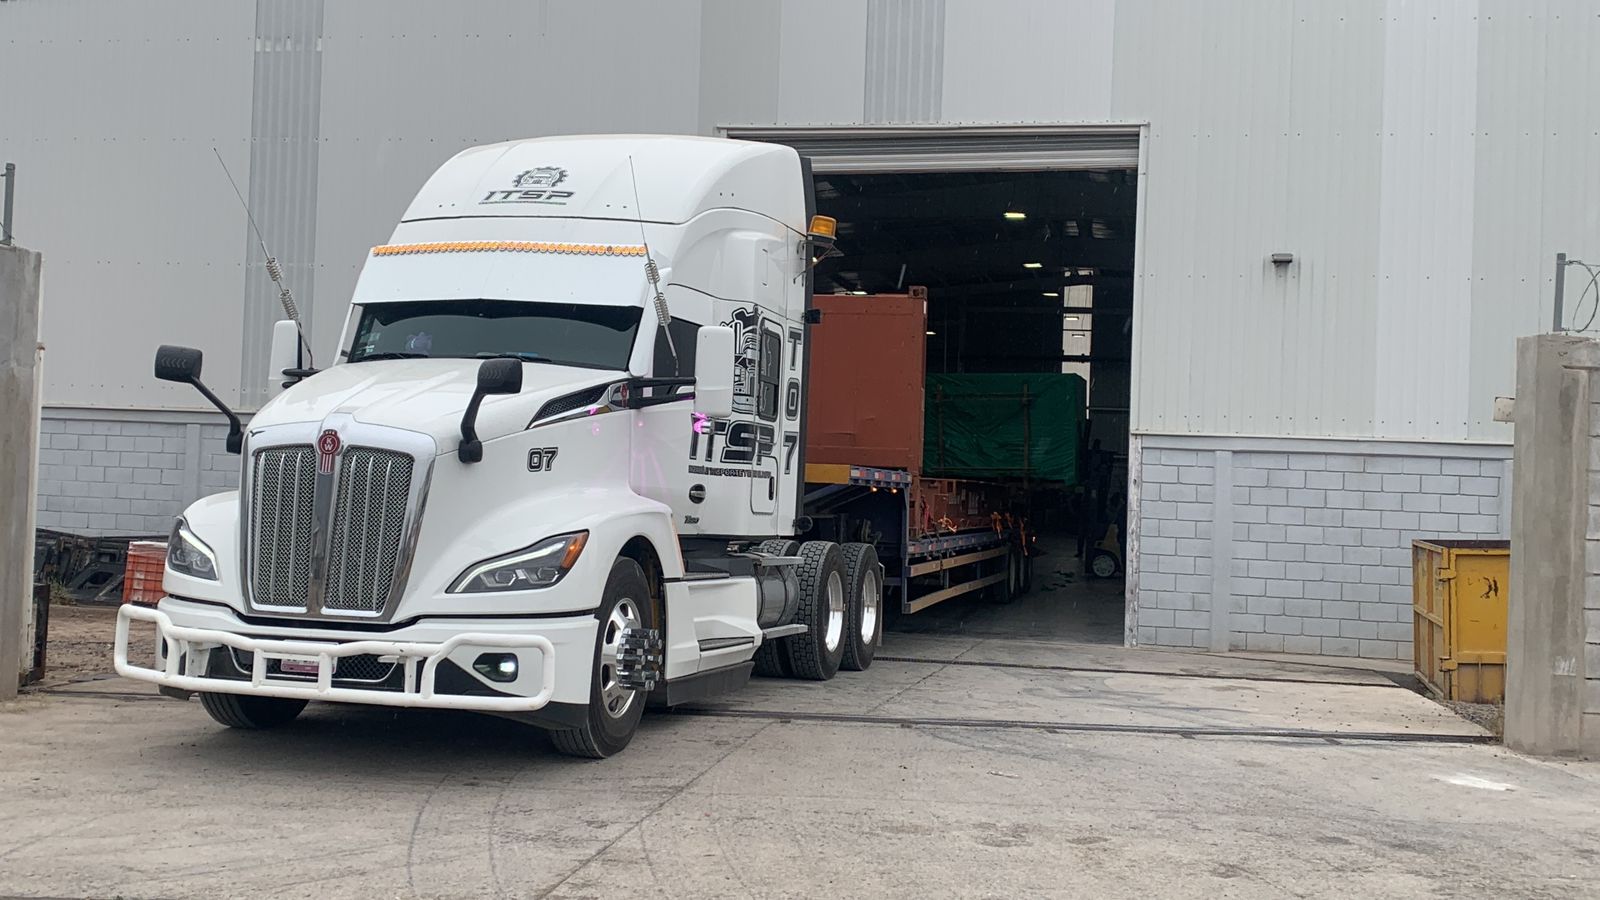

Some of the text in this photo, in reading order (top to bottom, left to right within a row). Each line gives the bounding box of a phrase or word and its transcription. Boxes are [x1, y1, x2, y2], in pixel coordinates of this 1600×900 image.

[483, 190, 576, 200] ITSP
[689, 413, 775, 466] ITSP
[527, 447, 559, 472] 07
